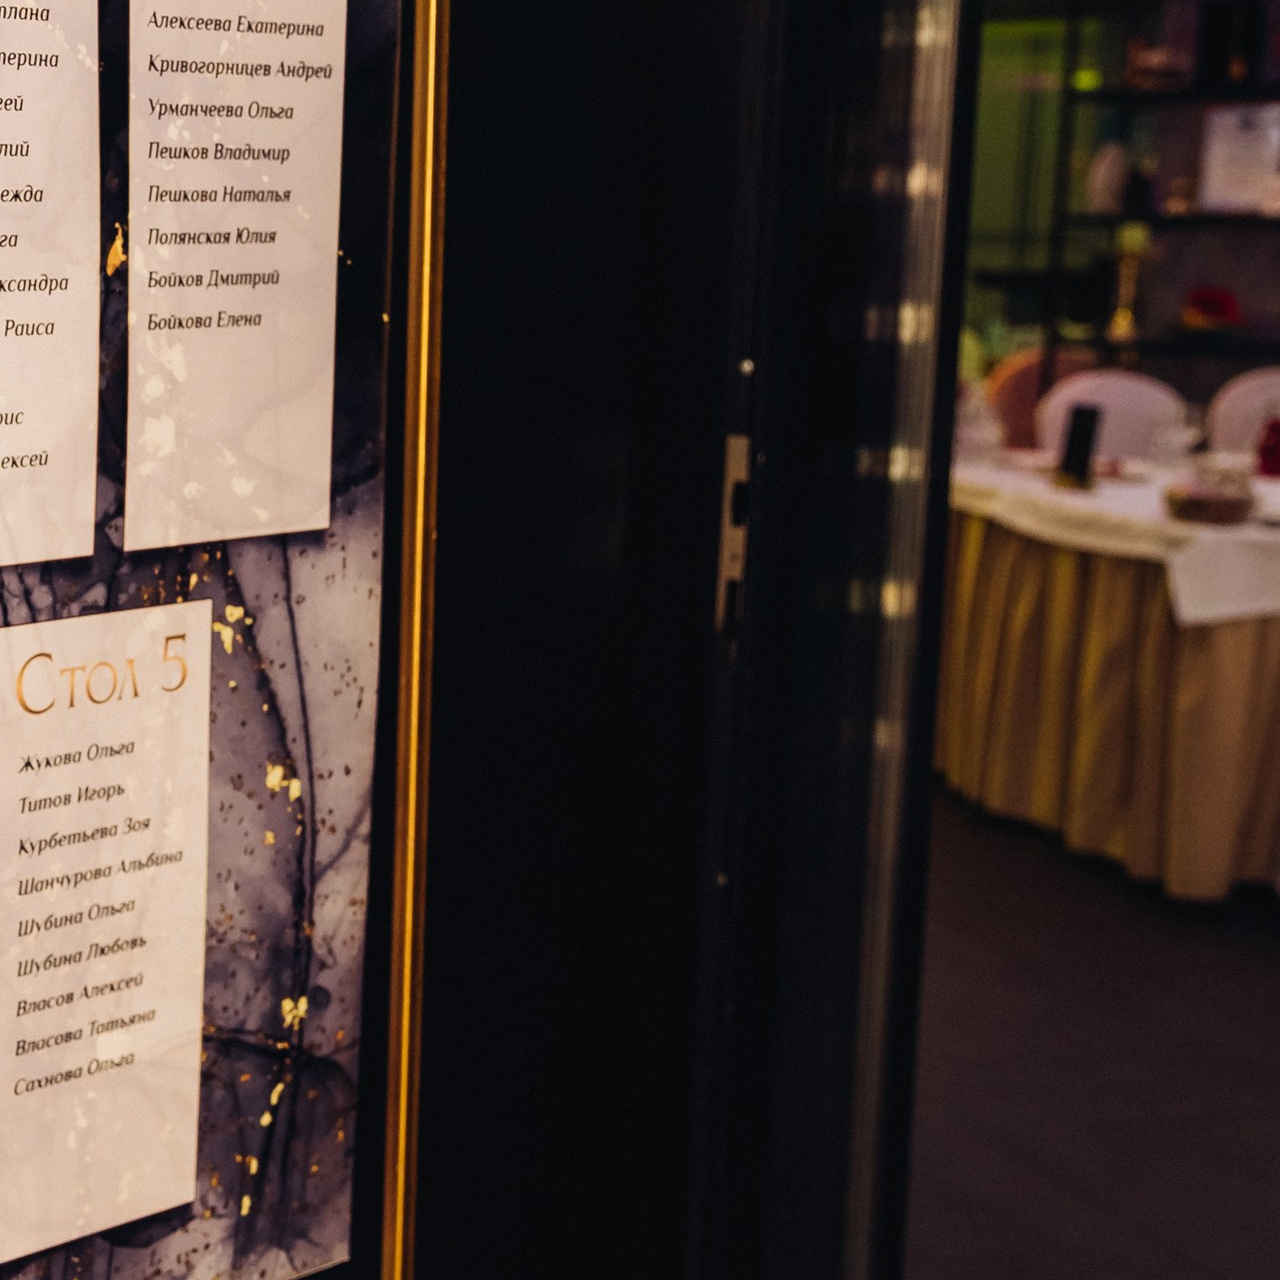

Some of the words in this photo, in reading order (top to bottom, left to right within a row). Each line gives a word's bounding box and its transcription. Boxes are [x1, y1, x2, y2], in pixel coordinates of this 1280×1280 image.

[148, 11, 231, 31] Алексеева
[237, 16, 324, 39] Екатерина
[276, 61, 332, 82] Андрей
[149, 98, 243, 120] Урманчеева
[248, 101, 294, 119] Ольга
[148, 142, 209, 159] Пешков
[214, 143, 290, 164] Владимир
[148, 185, 217, 202] Пешкова
[223, 186, 291, 202] Наталья
[148, 228, 231, 245] Полянская
[236, 227, 277, 244] Юлия
[148, 271, 203, 288] Бойков
[206, 269, 280, 289] Дмитрий
[5, 318, 54, 336] Раиса
[148, 314, 212, 330] Бойкова
[217, 311, 262, 327] Елена
[17, 652, 139, 715] Стол
[162, 633, 187, 692] 5
[19, 751, 82, 773] Жукова
[87, 742, 135, 761] Ольга
[20, 794, 72, 814] Титов
[77, 785, 125, 803] Игорь
[122, 817, 151, 835] Зоя
[117, 851, 183, 874] Альбина
[18, 912, 83, 937] Шубина
[87, 900, 135, 921] Ольга
[17, 951, 83, 977] Шубина
[86, 937, 147, 960] Любовь
[16, 992, 74, 1017] Власов
[79, 972, 144, 999] Алексей
[15, 1029, 82, 1056] Власова
[89, 1009, 156, 1037] Татьяна
[87, 1053, 135, 1076] Ольга
